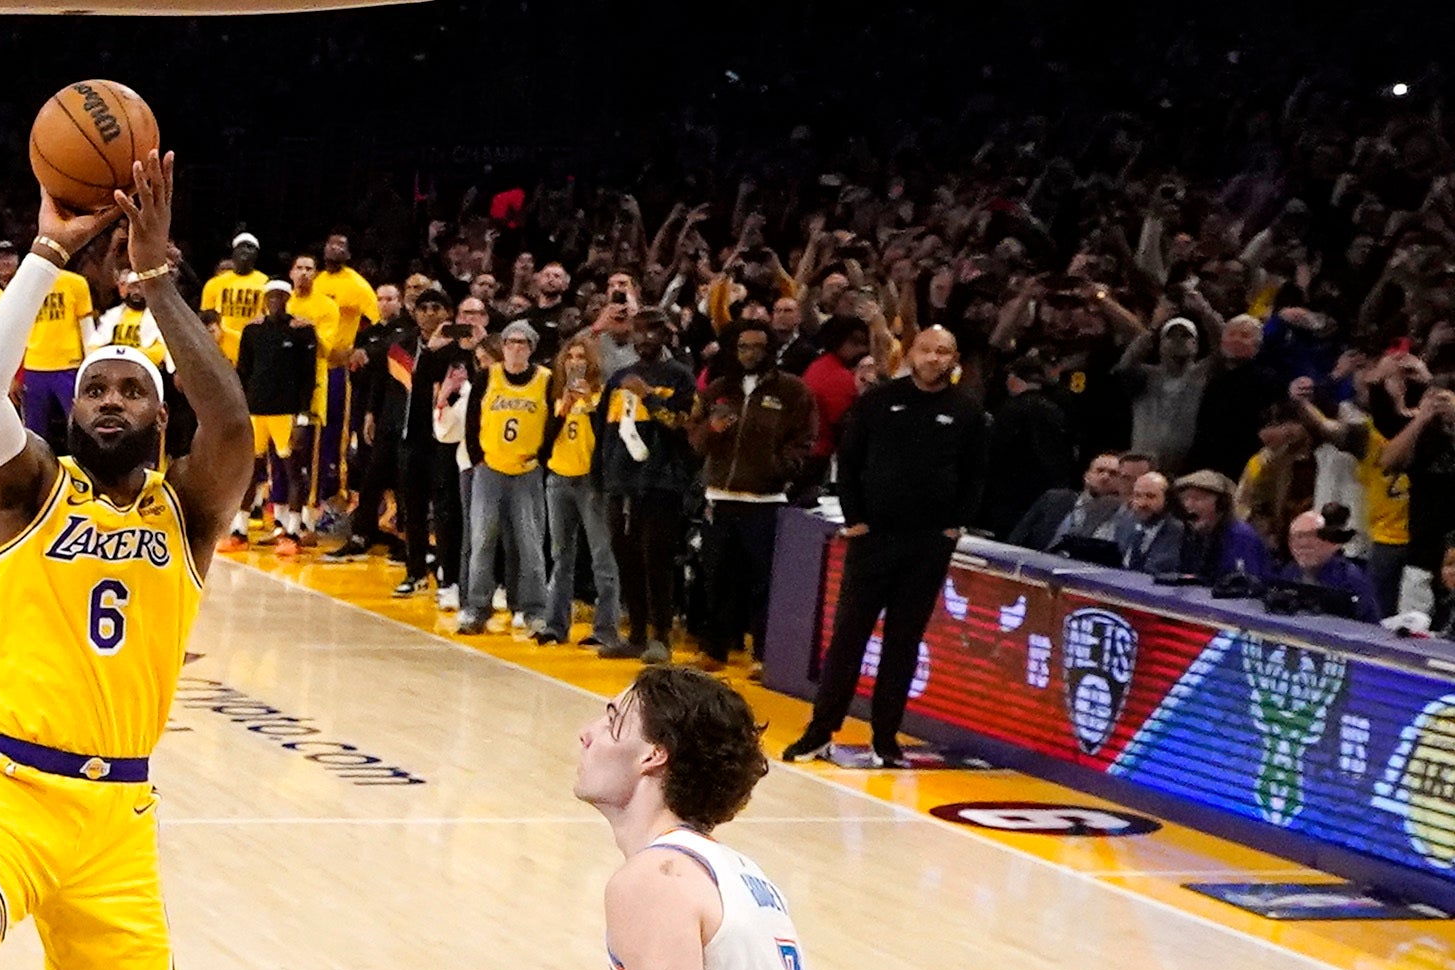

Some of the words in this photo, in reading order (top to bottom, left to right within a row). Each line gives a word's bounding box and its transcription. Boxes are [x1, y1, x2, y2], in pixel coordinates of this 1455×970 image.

[222, 288, 262, 304] BLACK
[503, 417, 519, 442] 6
[567, 420, 579, 441] 6
[44, 514, 172, 568] LAKERS
[88, 577, 130, 656] 6
